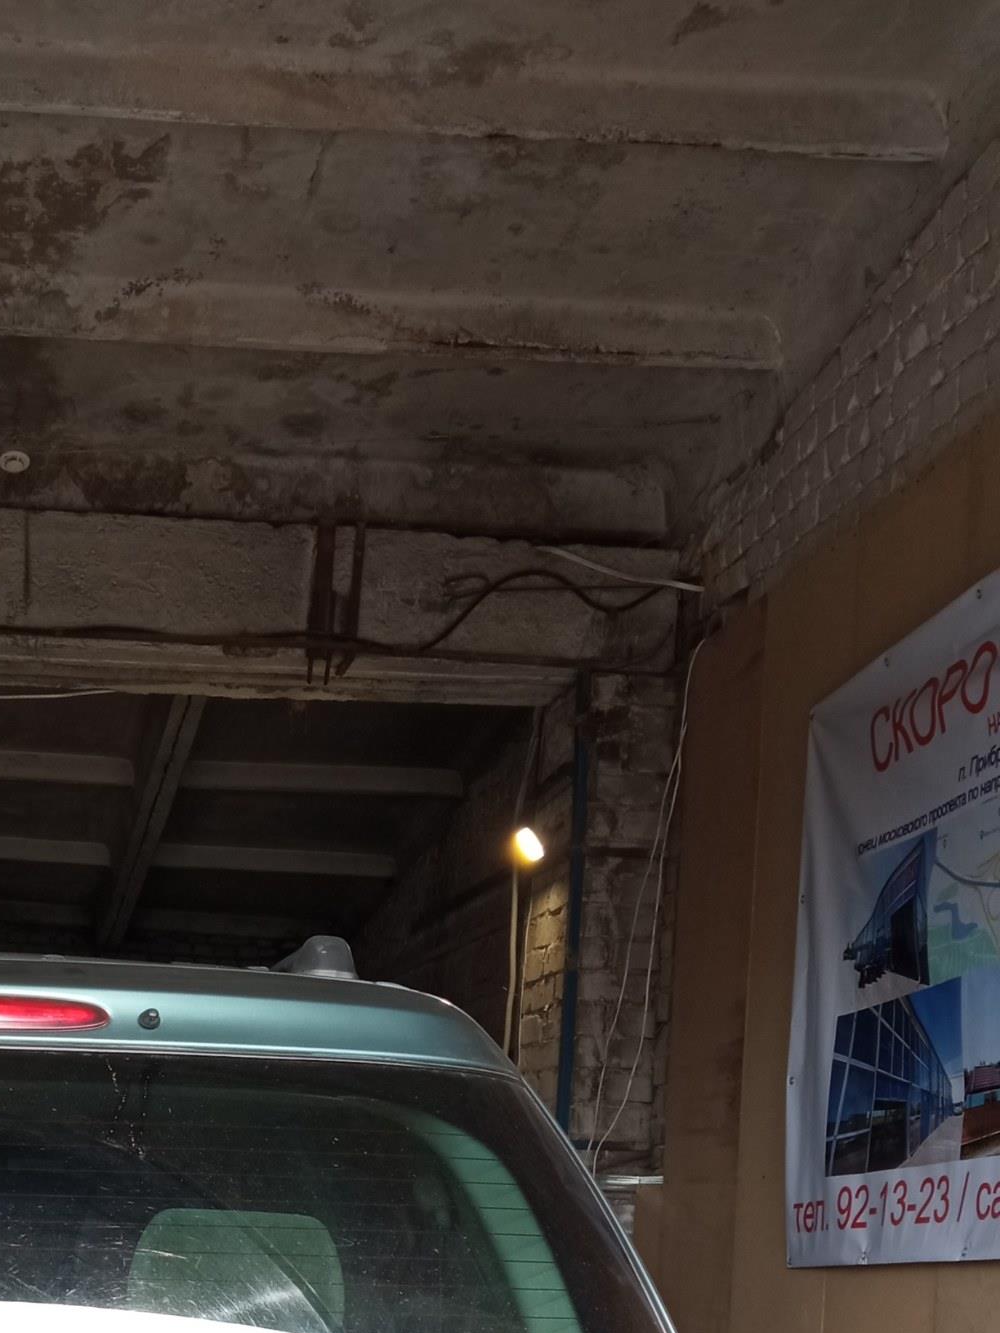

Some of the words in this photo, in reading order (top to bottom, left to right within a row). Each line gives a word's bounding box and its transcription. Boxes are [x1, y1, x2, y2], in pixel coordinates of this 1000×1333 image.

[870, 640, 998, 772] СКОРО
[968, 787, 978, 803] по
[793, 1200, 829, 1234] тел.
[837, 1175, 949, 1230] 92-13-23
[957, 1171, 970, 1223] /
